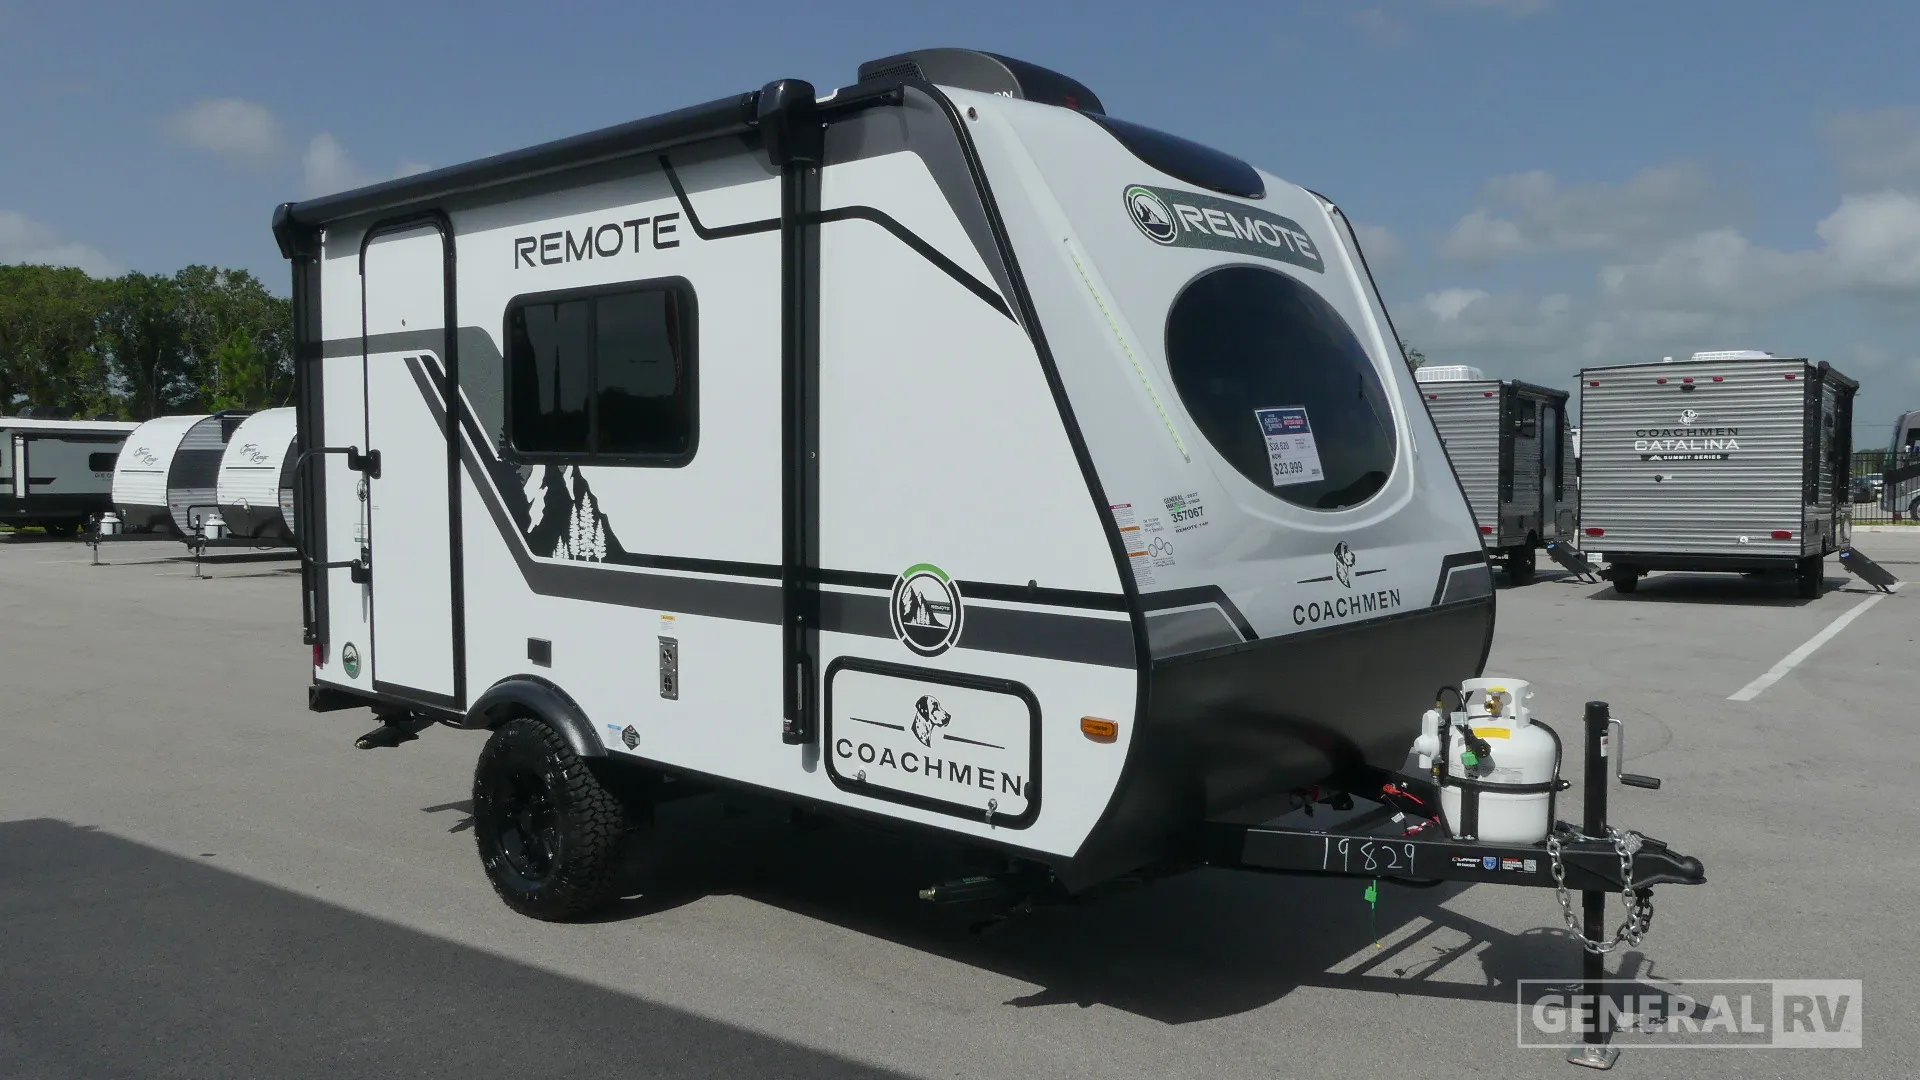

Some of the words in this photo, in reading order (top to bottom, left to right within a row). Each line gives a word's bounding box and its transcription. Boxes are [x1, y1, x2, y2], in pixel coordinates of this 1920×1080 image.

[514, 212, 680, 269] REMOTE
[1172, 203, 1318, 260] REMOTE
[1634, 439, 1740, 451] CATALINA
[1635, 427, 1739, 437] COACHMEN
[1274, 461, 1303, 476] $23,999
[1171, 506, 1203, 523] 357067
[1293, 588, 1401, 626] COACHMEN
[836, 738, 1022, 797] COACHMEN
[1323, 837, 1415, 874] 19829
